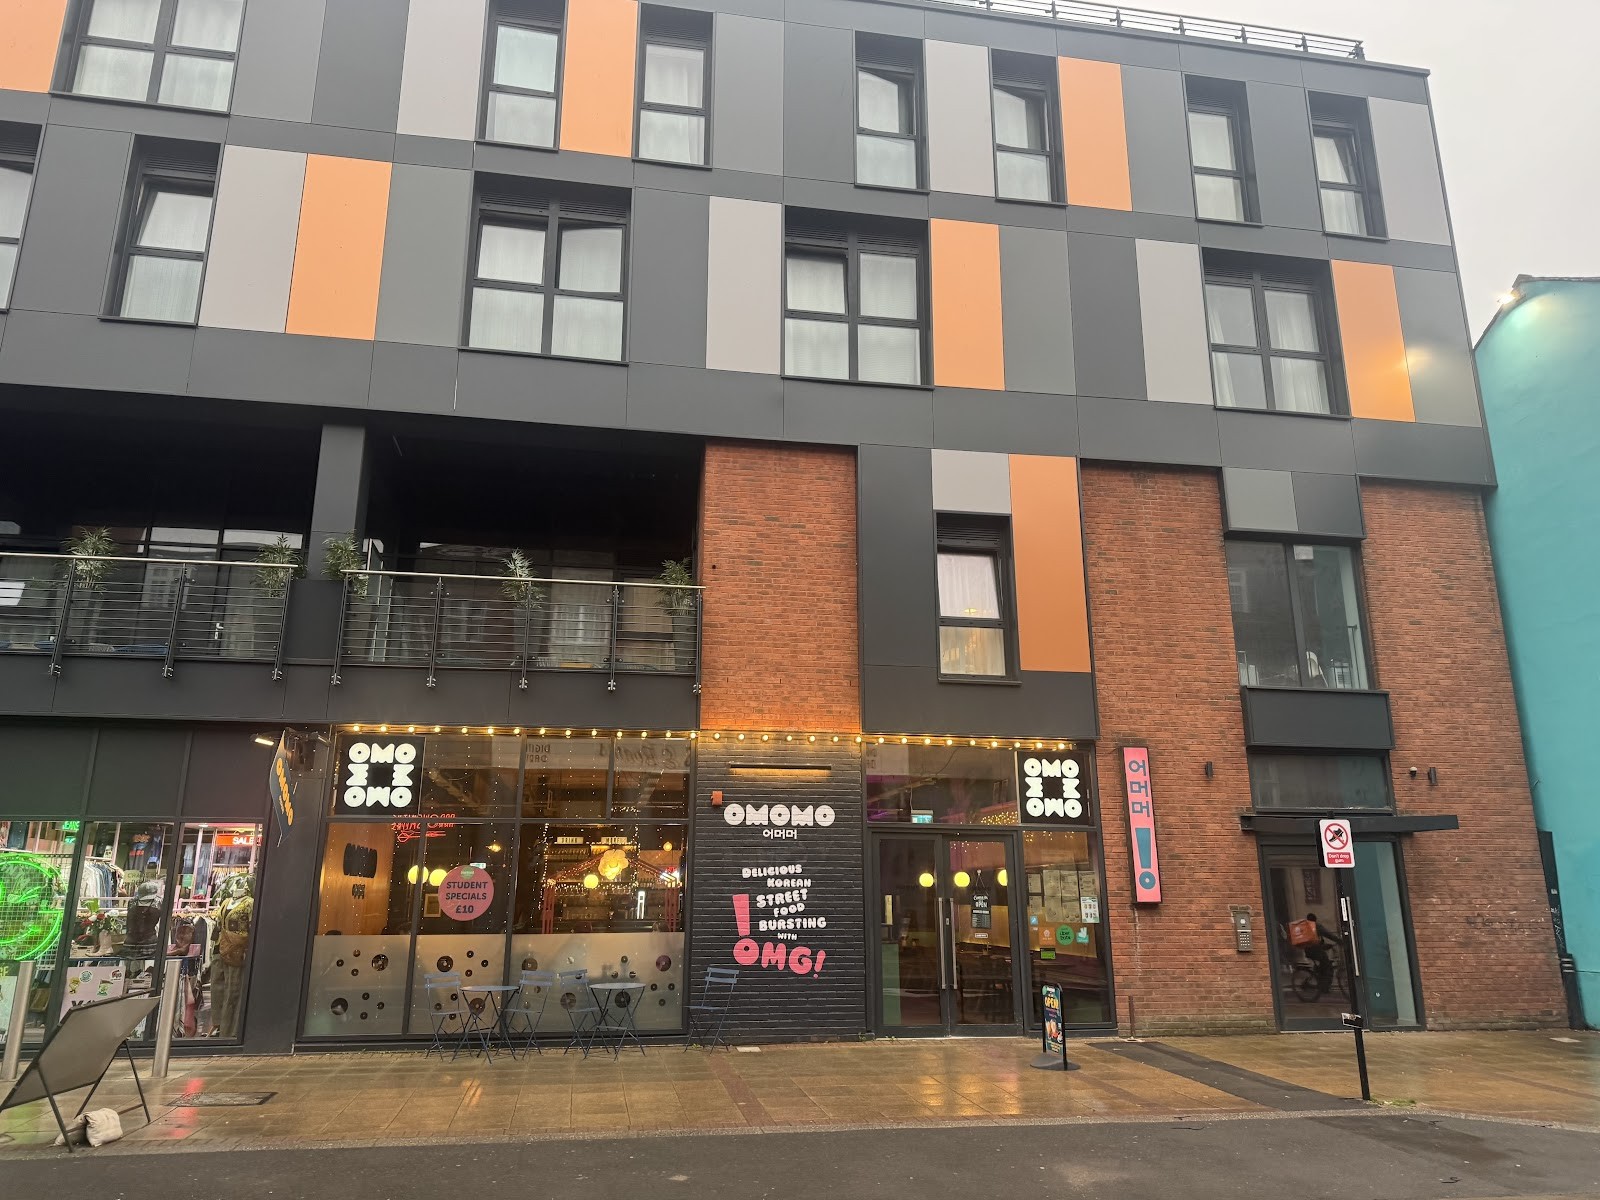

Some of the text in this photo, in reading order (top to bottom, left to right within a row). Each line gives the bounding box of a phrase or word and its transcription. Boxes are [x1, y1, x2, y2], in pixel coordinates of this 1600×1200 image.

[723, 803, 836, 826] OMOMO
[232, 836, 254, 845] SALE
[762, 828, 798, 840] 어머머
[742, 864, 803, 878] DELICIOUS
[767, 878, 812, 887] KOREAN
[756, 888, 808, 908] STREET
[456, 905, 474, 914] £10
[774, 903, 805, 917] FOOD
[759, 917, 827, 931] BURSTING
